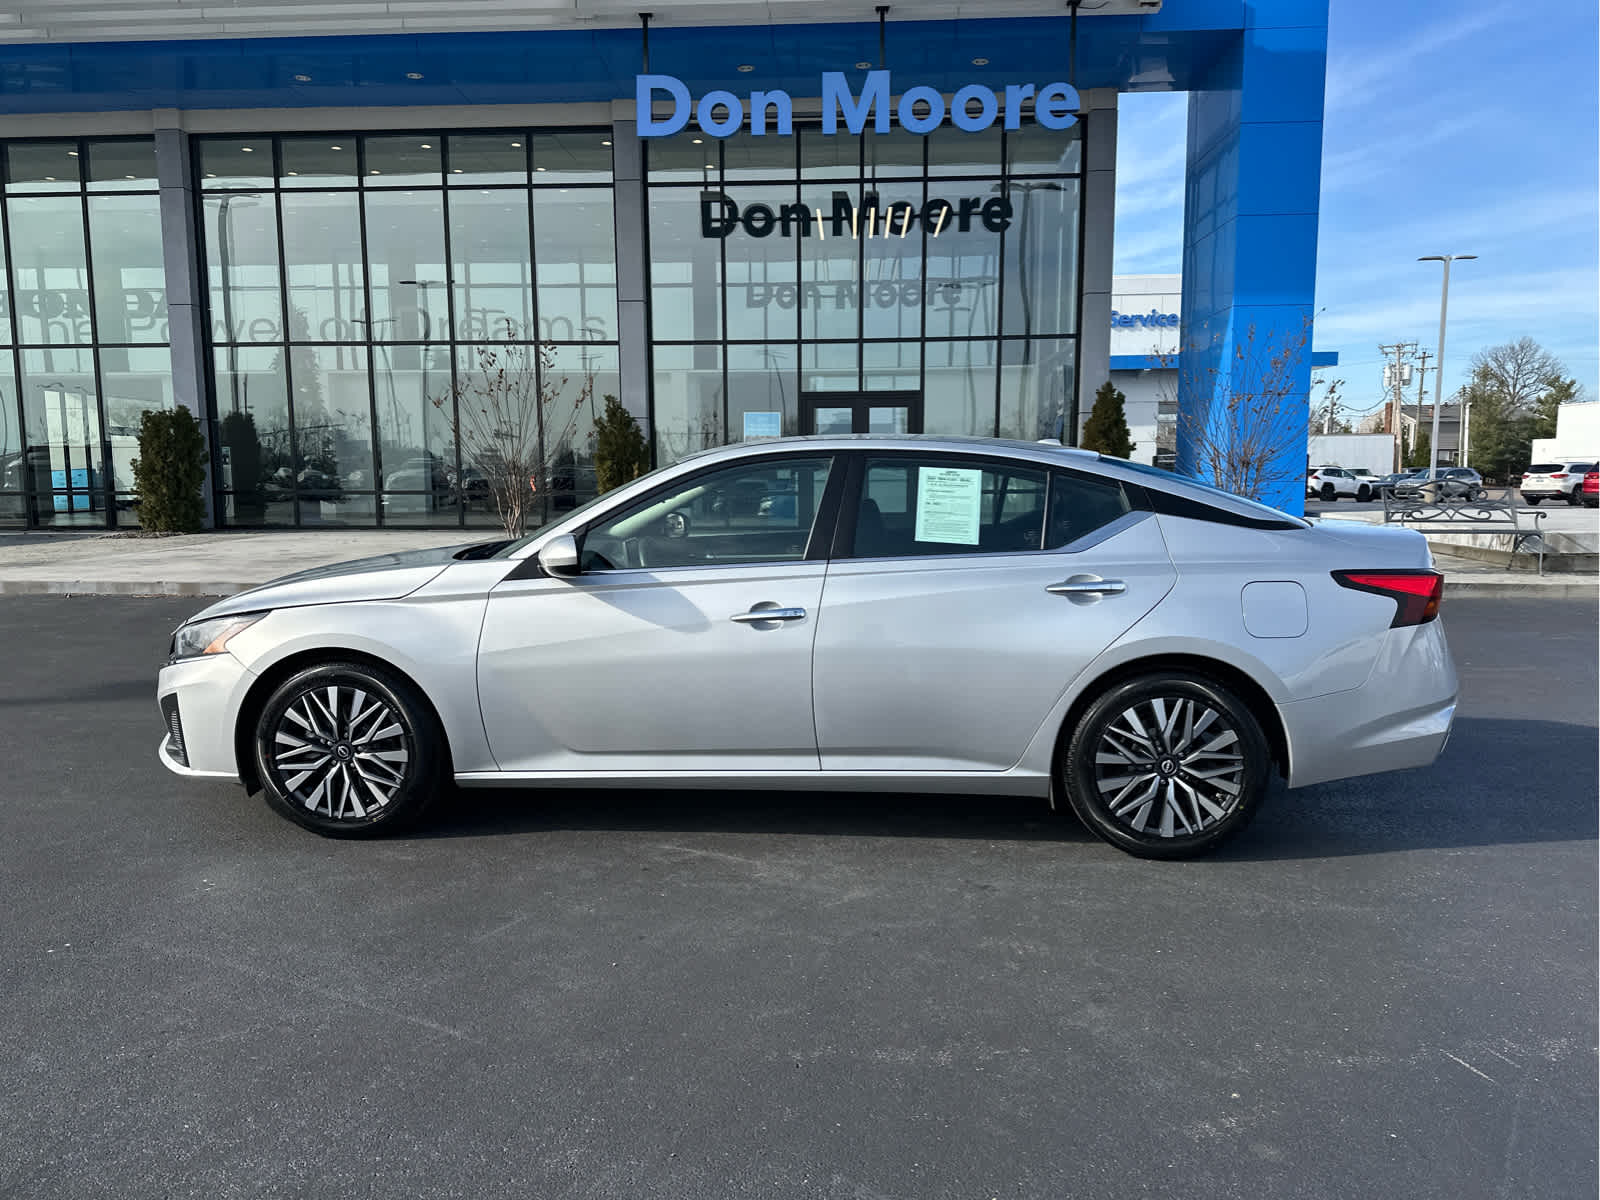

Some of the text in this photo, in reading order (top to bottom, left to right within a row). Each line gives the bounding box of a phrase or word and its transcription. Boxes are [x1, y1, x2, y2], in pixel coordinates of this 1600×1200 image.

[636, 70, 1081, 138] Don Moore
[700, 189, 1013, 238] Don Moore
[746, 282, 821, 309] Don
[1111, 309, 1179, 328] Service
